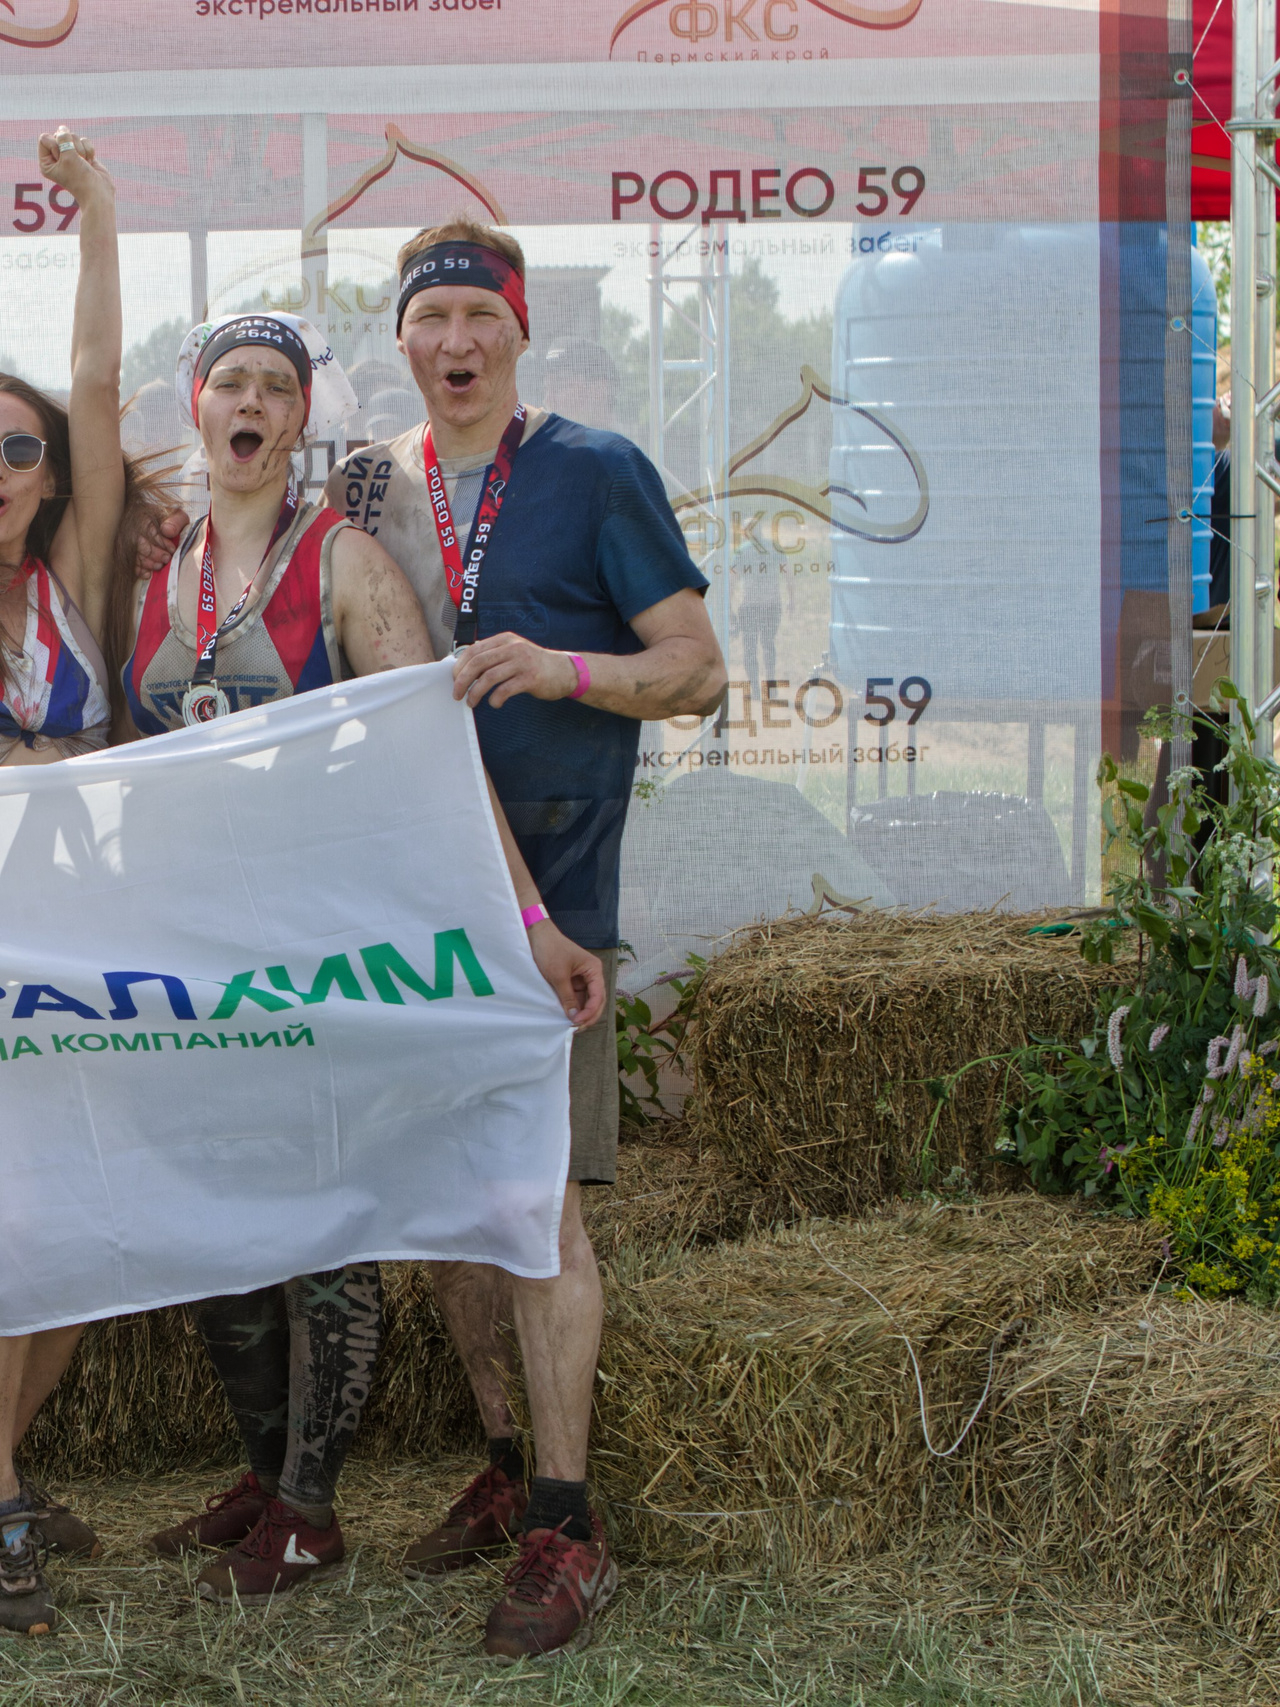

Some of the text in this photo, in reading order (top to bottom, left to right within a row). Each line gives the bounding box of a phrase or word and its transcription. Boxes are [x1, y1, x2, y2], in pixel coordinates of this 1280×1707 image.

[669, 0, 799, 42] ФКС
[637, 48, 830, 65] Пермский край
[12, 183, 79, 233] 59
[612, 165, 926, 227] РОДЕО 59
[613, 233, 835, 259] экстремальный
[444, 258, 470, 270] 59
[235, 329, 283, 344] 2644
[428, 465, 455, 548] РОДЕО 59
[680, 511, 806, 556] ФКС
[461, 523, 491, 613] РОДЕО 59
[779, 561, 836, 576] край
[201, 593, 214, 612] 59
[863, 676, 933, 727] 59
[853, 741, 931, 763] забег
[52, 1022, 316, 1054] КОМПАНИЙ
